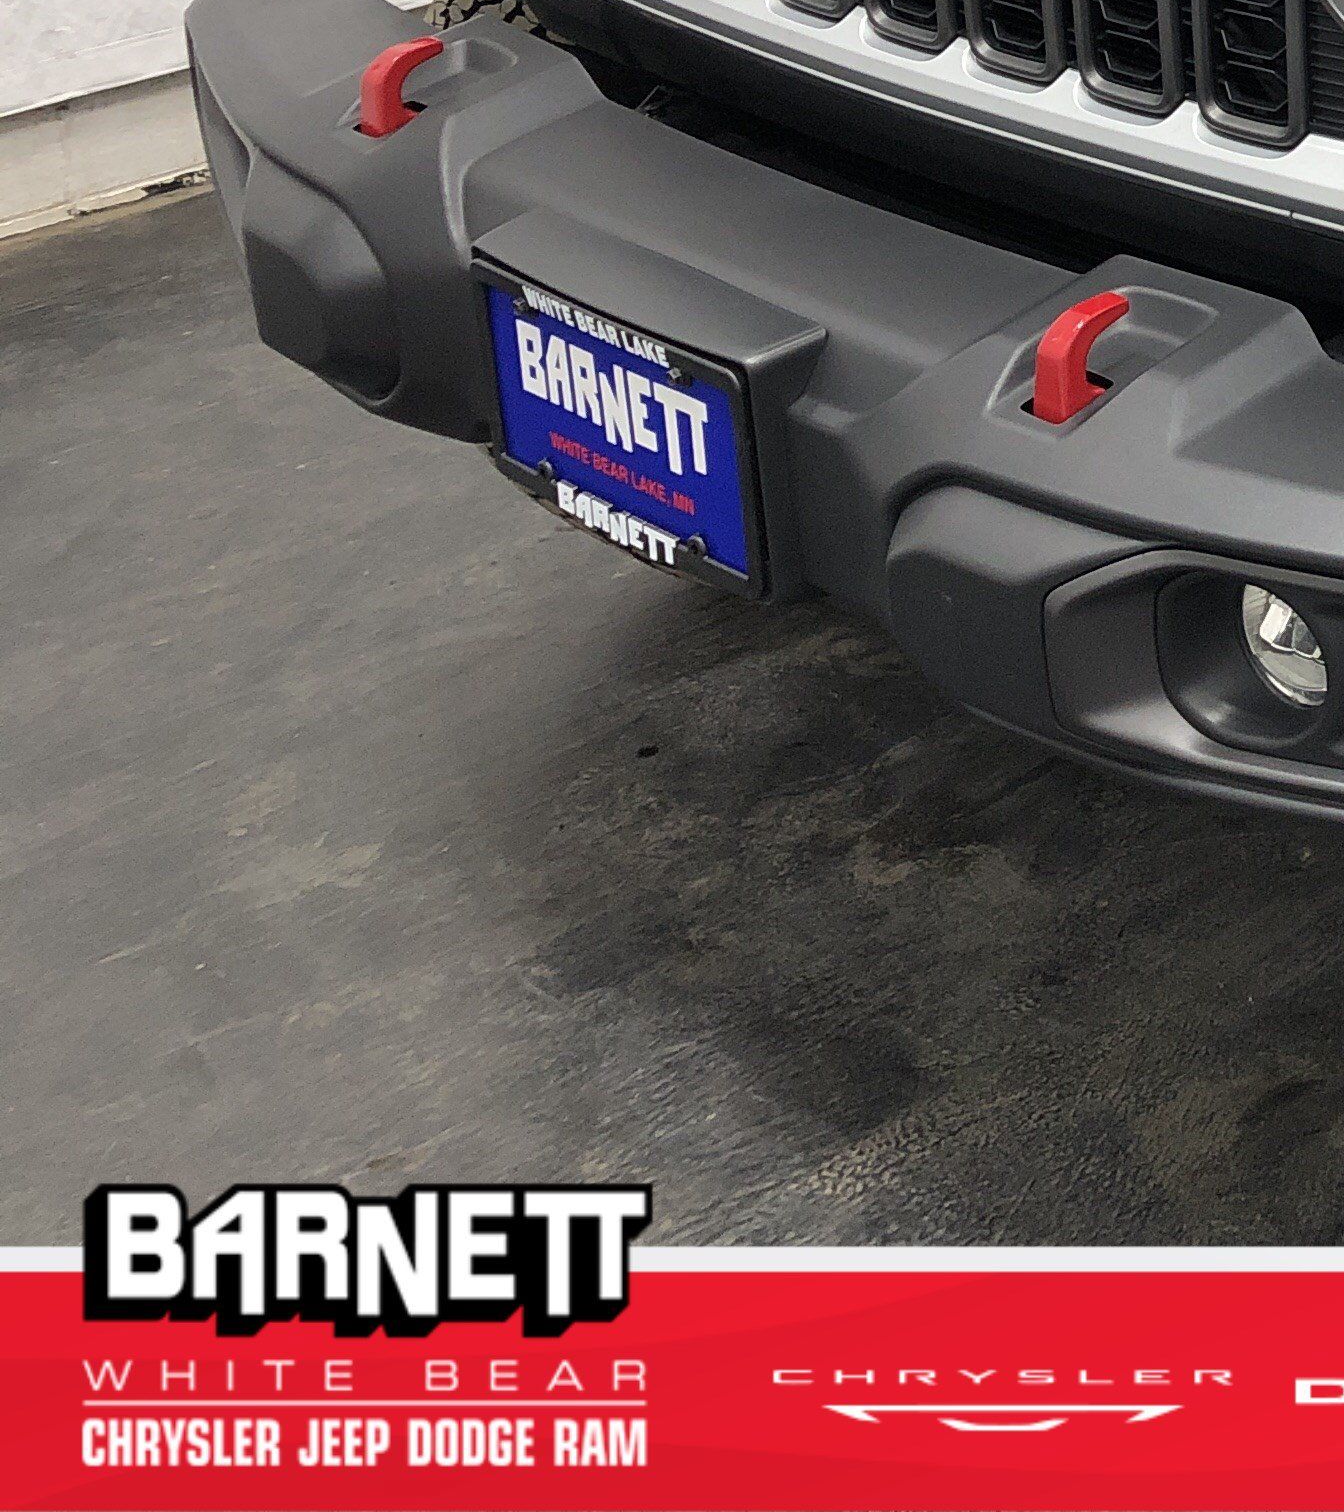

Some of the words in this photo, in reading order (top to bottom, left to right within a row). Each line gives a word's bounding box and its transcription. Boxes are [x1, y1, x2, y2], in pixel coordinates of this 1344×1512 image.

[522, 285, 574, 328] WHITE
[574, 310, 620, 349] BEAR
[620, 330, 670, 369] LAKE
[515, 319, 708, 476] BARNETT
[549, 431, 590, 465] WHITE
[590, 449, 629, 483] BEAR
[672, 492, 696, 516] MN
[557, 479, 680, 566] BARNETT
